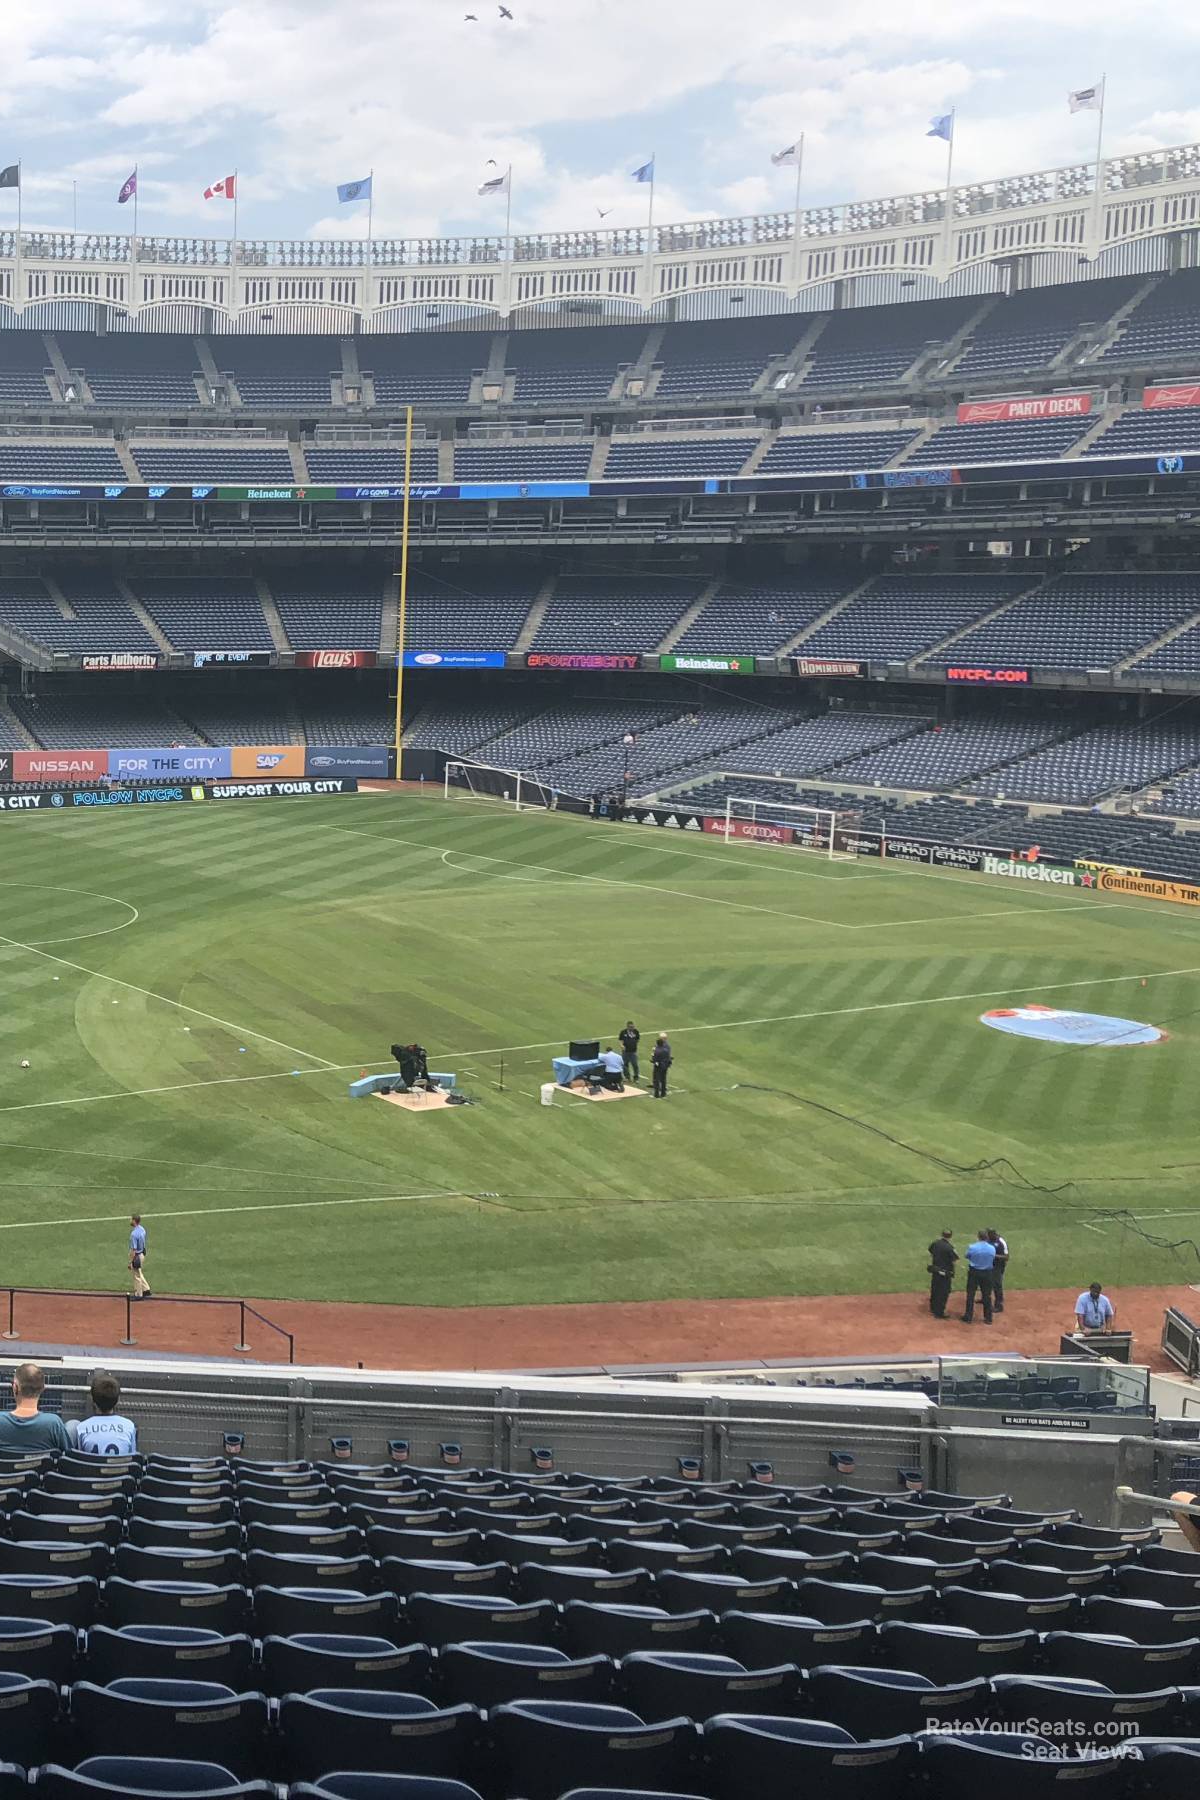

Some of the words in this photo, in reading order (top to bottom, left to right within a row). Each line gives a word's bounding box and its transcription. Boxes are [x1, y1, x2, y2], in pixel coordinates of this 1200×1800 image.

[1008, 402, 1046, 417] PARTY
[1049, 398, 1082, 414] DECK
[31, 488, 81, 496] BuyFordNow.com
[104, 488, 121, 497] SAP
[149, 488, 165, 497] SAP
[192, 489, 209, 498] SAP
[247, 489, 292, 499] Heineken
[82, 656, 109, 666] Parts
[110, 654, 157, 667] Authority
[527, 654, 638, 669] #FORTHECITY
[675, 658, 729, 670] Heineken
[948, 668, 1028, 682] NYCFC.COM
[29, 760, 94, 772] NISSAN
[118, 759, 148, 771] FOR
[152, 758, 180, 770] THE
[183, 757, 217, 770] CITY
[256, 755, 281, 768] SAP
[213, 784, 273, 798] SUPPORT
[275, 782, 312, 795] YOUR
[314, 780, 343, 792] CITY
[8, 795, 41, 809] CITY
[73, 791, 133, 805] FOLLOW
[137, 788, 184, 802] NYCFC
[888, 844, 928, 856] ETIHAD
[935, 852, 979, 864] ETIHAD
[983, 857, 1075, 885] Heineken
[1102, 874, 1167, 896] Continental
[85, 1423, 124, 1434] LUCAS
